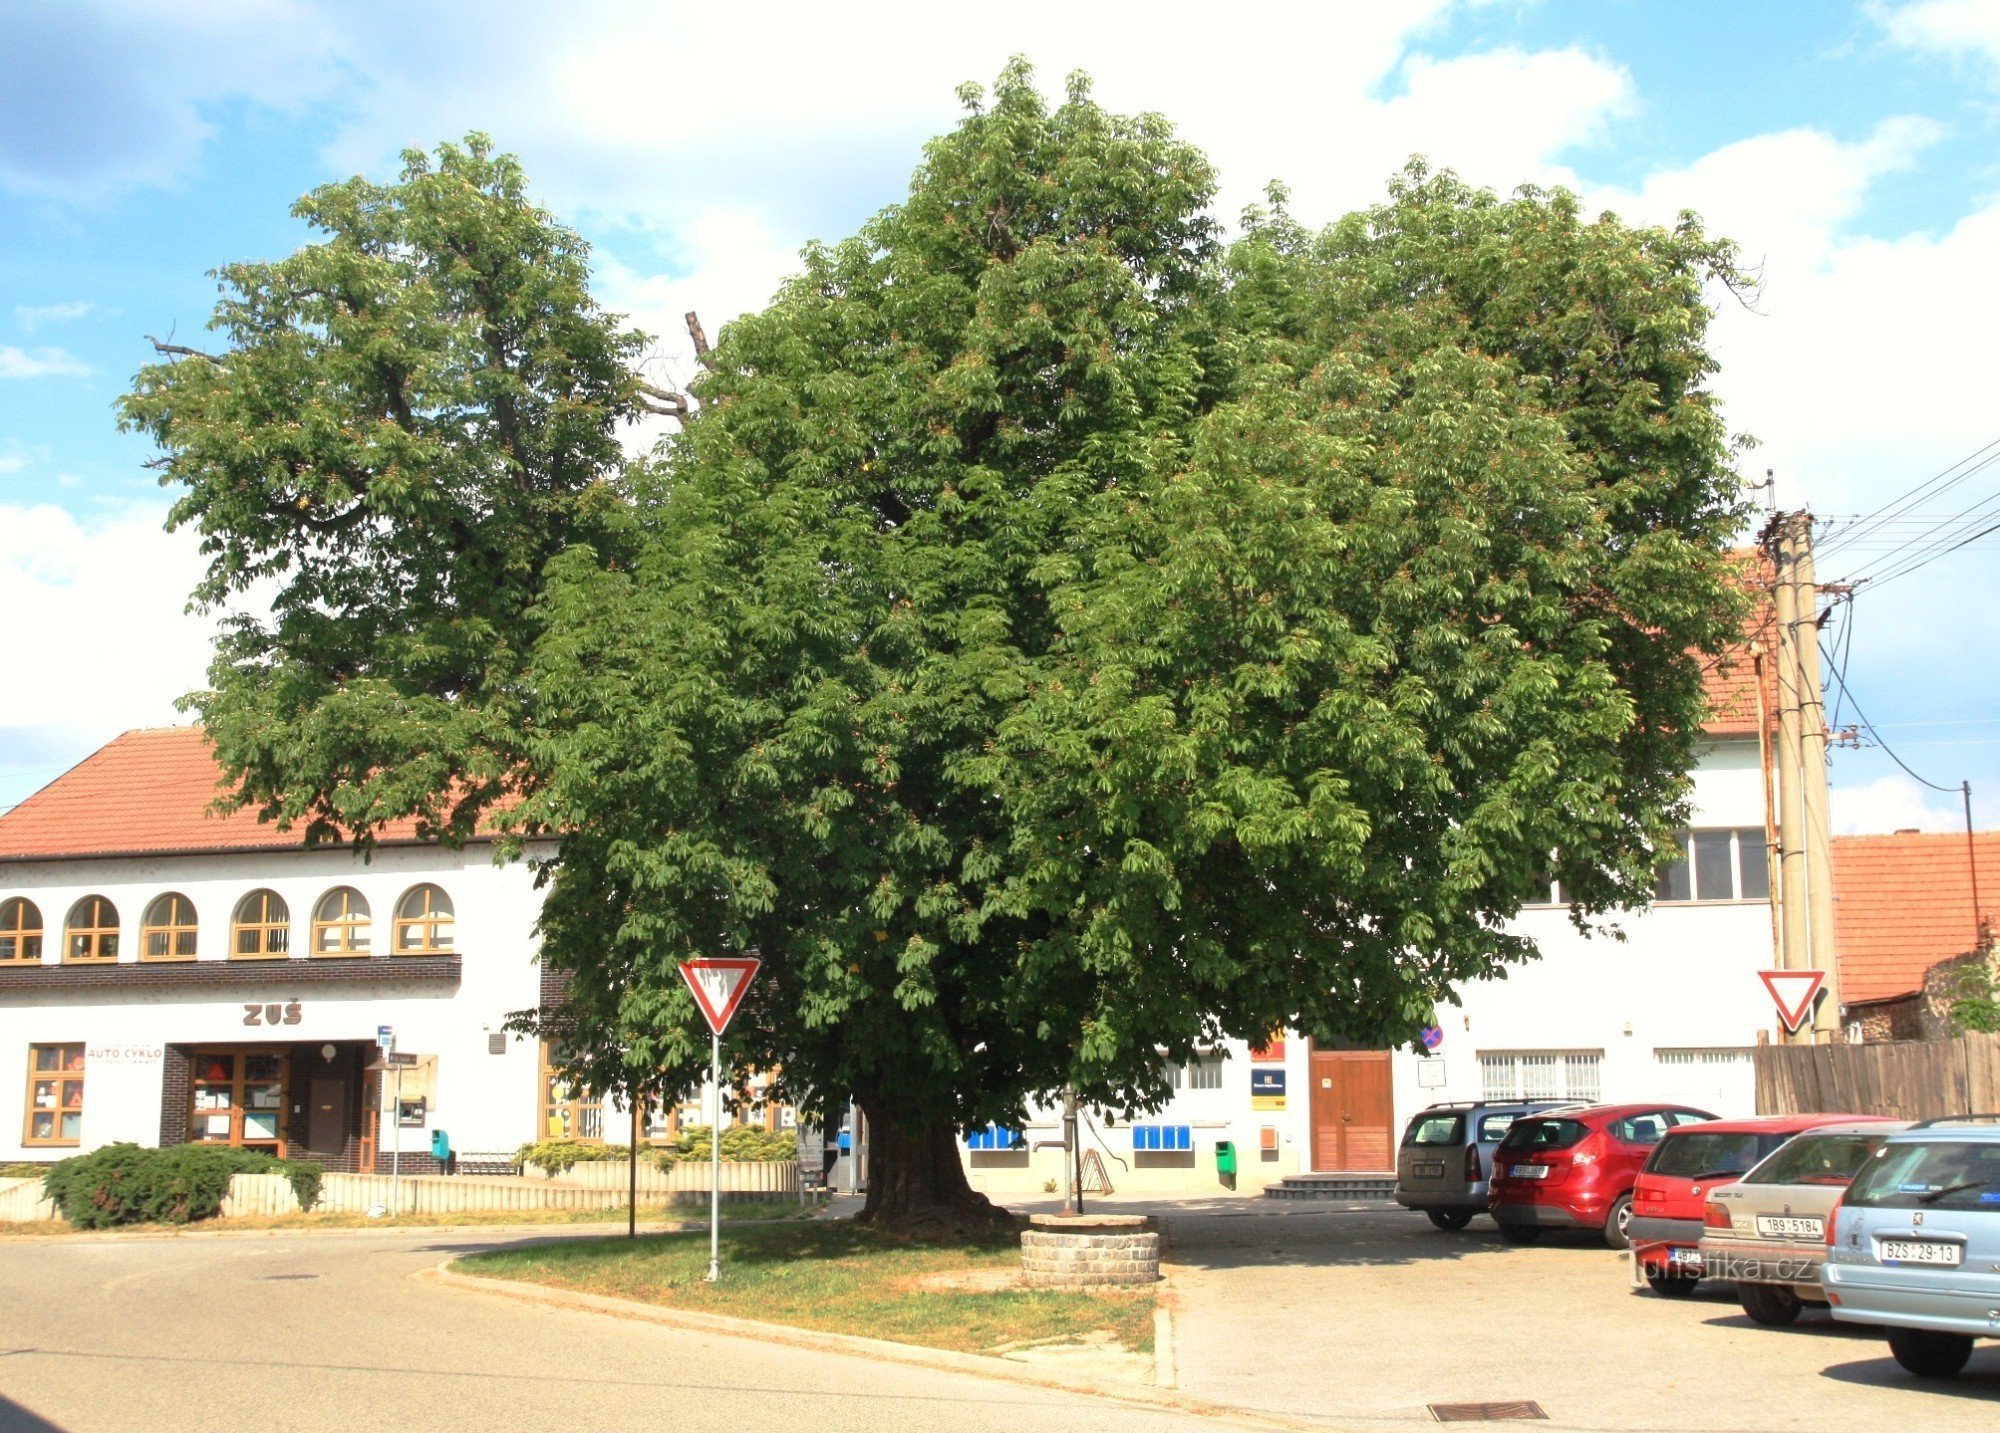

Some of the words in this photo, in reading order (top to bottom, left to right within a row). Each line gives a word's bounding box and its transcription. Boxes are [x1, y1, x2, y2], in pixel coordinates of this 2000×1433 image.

[243, 998, 302, 1026] ZUŠ
[88, 1049, 120, 1058] AUTO
[124, 1048, 162, 1058] CYKLO
[1768, 1219, 1785, 1231] 1B9
[1793, 1220, 1818, 1232] 5184
[1887, 1243, 1908, 1258] BZS
[1919, 1245, 1952, 1261] 29-13
